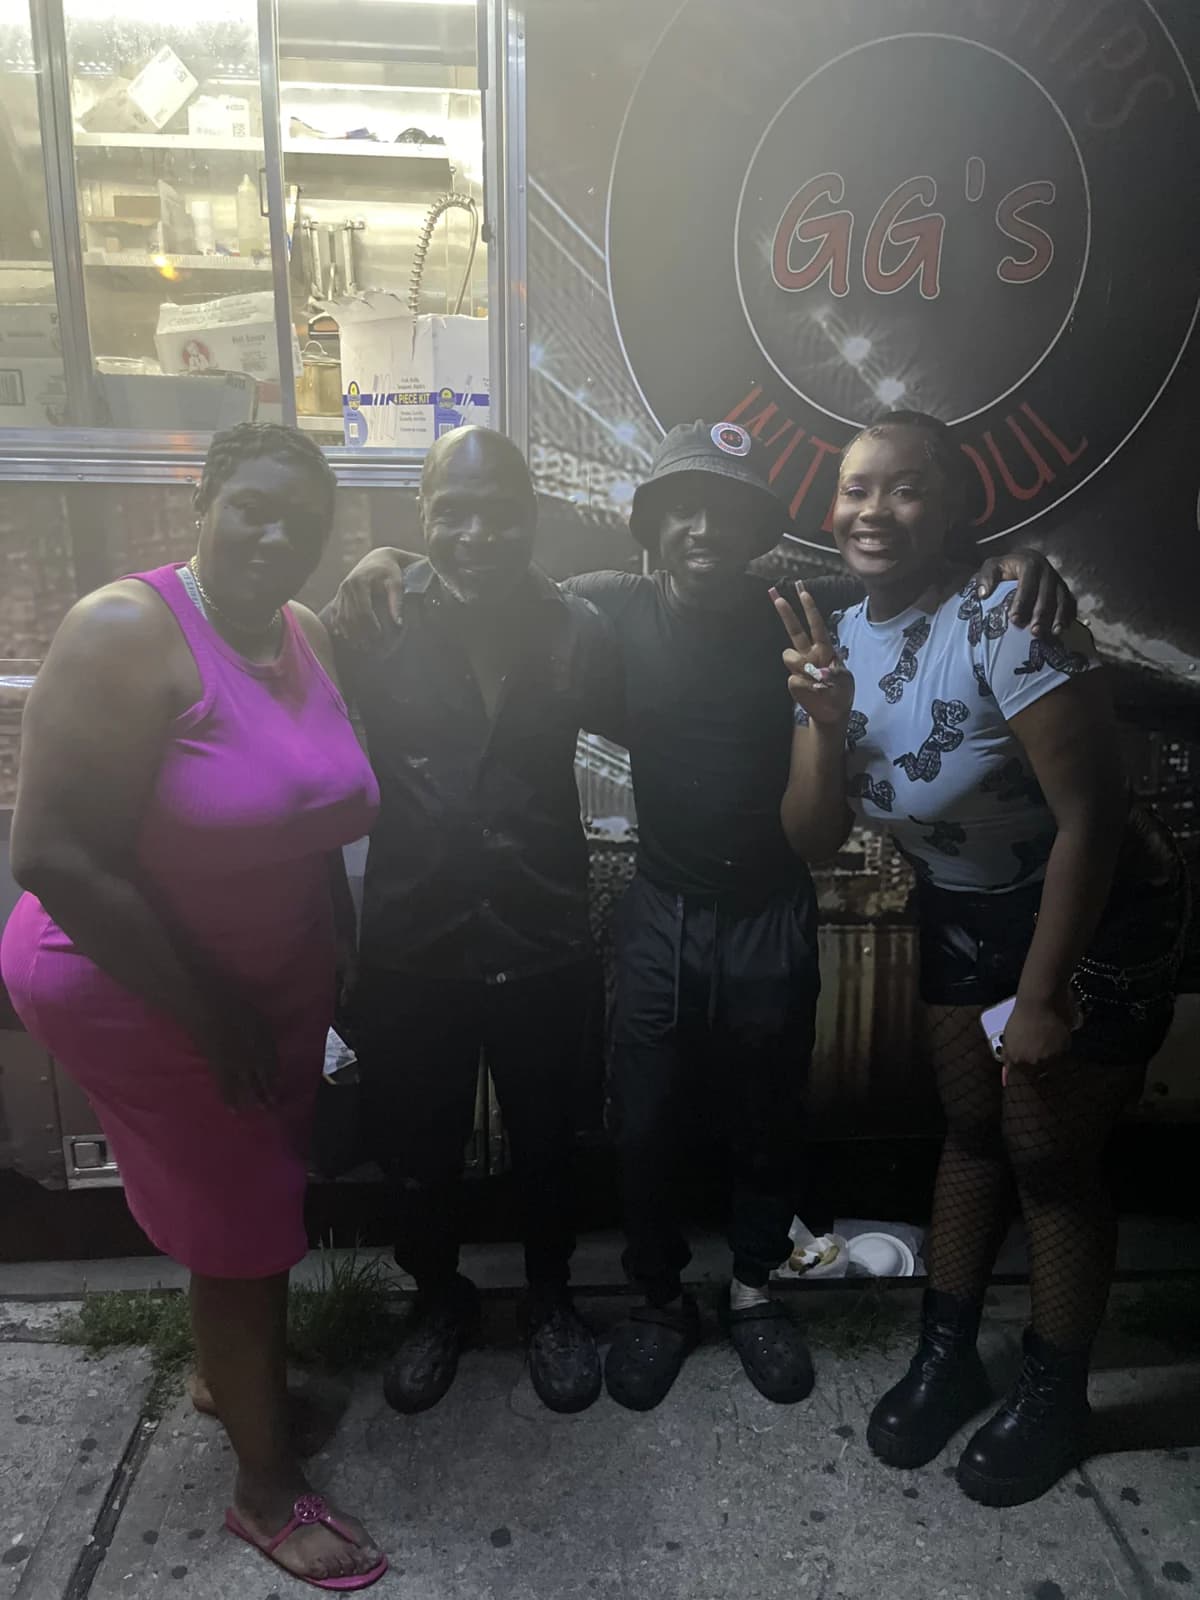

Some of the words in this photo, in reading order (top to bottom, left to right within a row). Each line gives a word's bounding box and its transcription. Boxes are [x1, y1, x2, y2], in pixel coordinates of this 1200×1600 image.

[398, 393, 417, 405] PIECE
[418, 392, 431, 405] KIT
[722, 384, 846, 532] WIT
